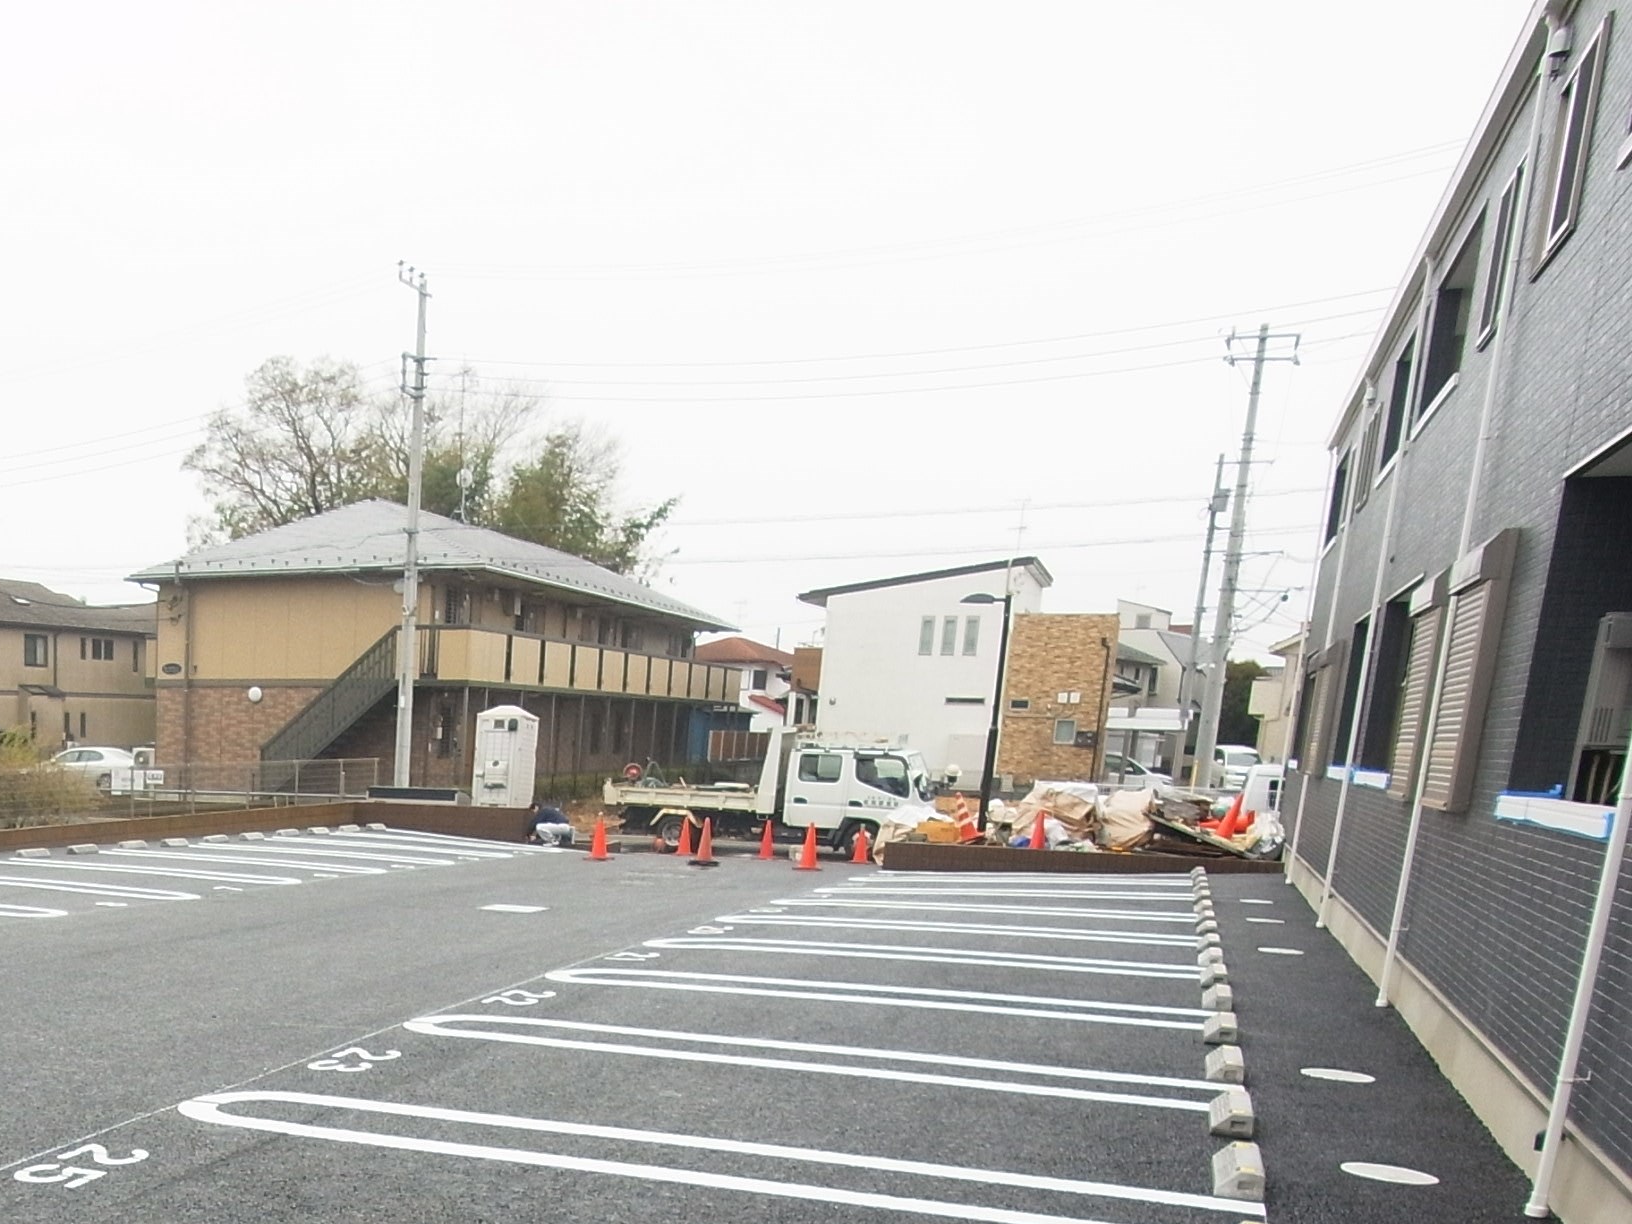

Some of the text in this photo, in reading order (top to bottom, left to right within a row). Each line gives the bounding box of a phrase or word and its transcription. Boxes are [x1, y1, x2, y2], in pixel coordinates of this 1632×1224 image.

[603, 950, 661, 962] 21
[479, 988, 557, 1007] 22
[306, 1046, 402, 1073] 23
[13, 1142, 150, 1189] 25
